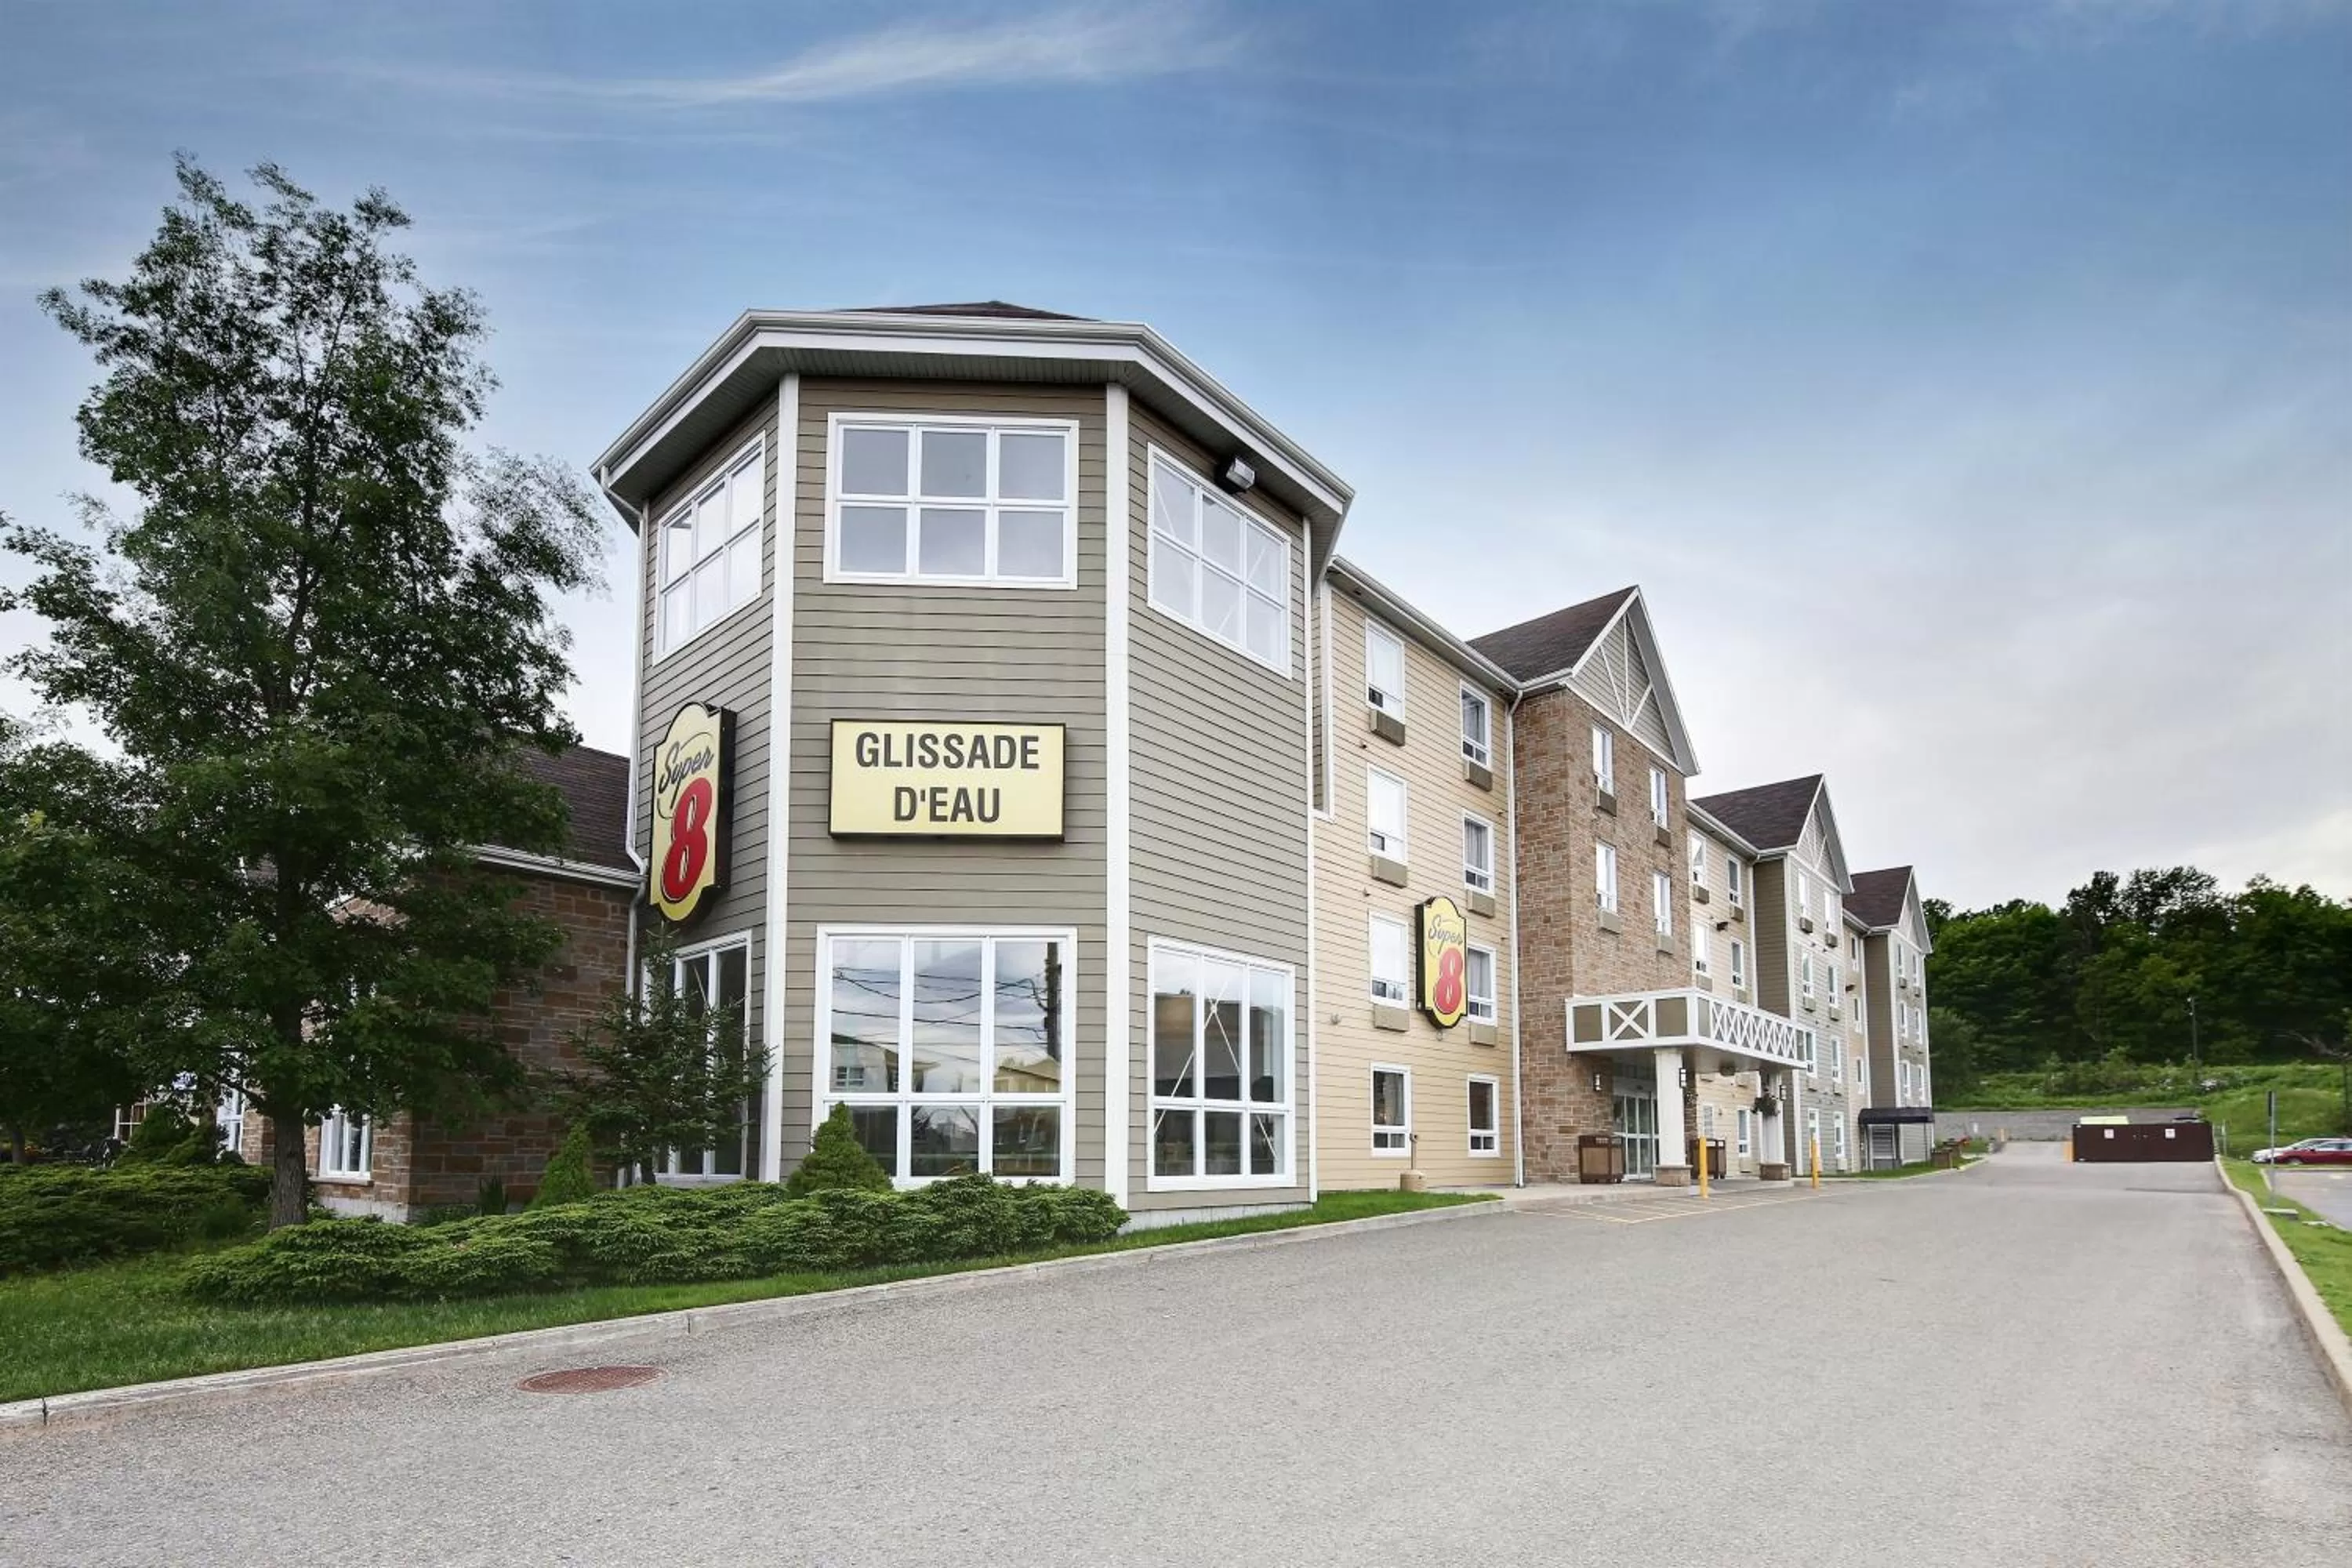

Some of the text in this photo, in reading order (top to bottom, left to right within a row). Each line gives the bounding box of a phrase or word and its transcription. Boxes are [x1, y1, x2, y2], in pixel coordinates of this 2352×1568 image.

[658, 739, 714, 811] Super
[856, 732, 1040, 769] GLISSADE
[894, 786, 1000, 822] D'EAU
[661, 777, 712, 902] 8
[1428, 914, 1463, 954] Super
[1434, 947, 1463, 1014] 8
